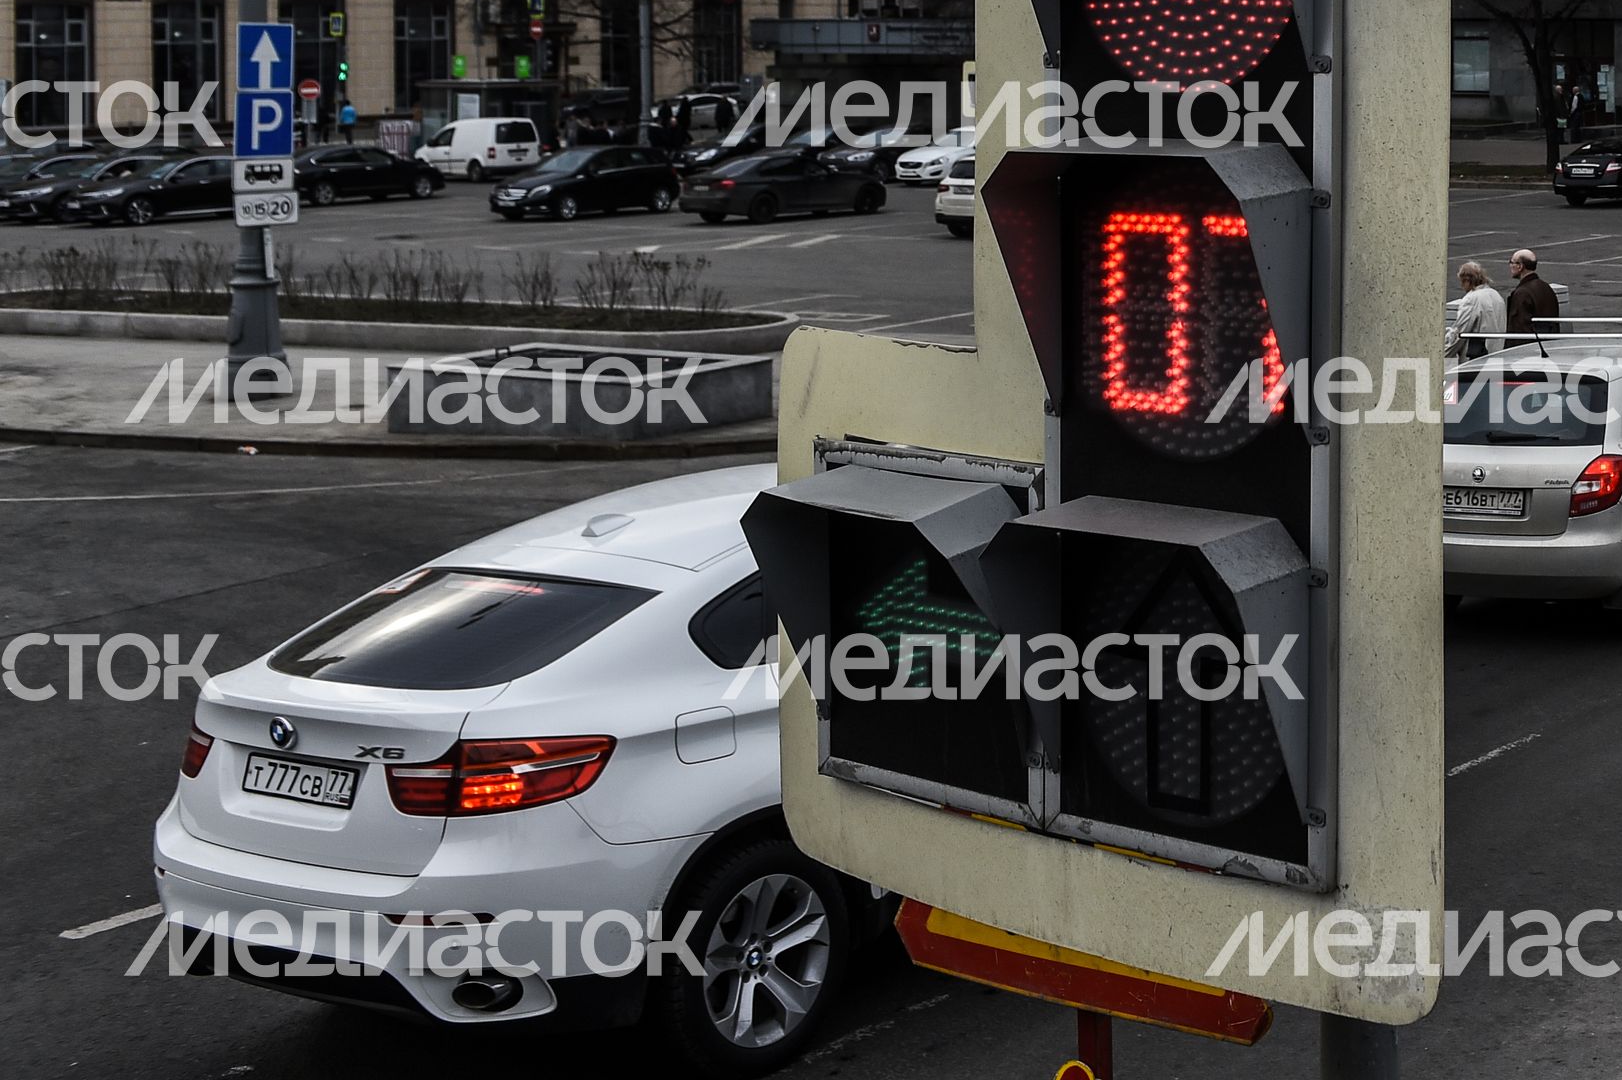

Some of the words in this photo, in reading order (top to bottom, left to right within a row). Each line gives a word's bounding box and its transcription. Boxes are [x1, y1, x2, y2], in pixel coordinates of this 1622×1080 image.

[251, 99, 282, 150] P
[255, 203, 266, 215] 15
[271, 201, 290, 215] 20
[355, 745, 405, 760] X6
